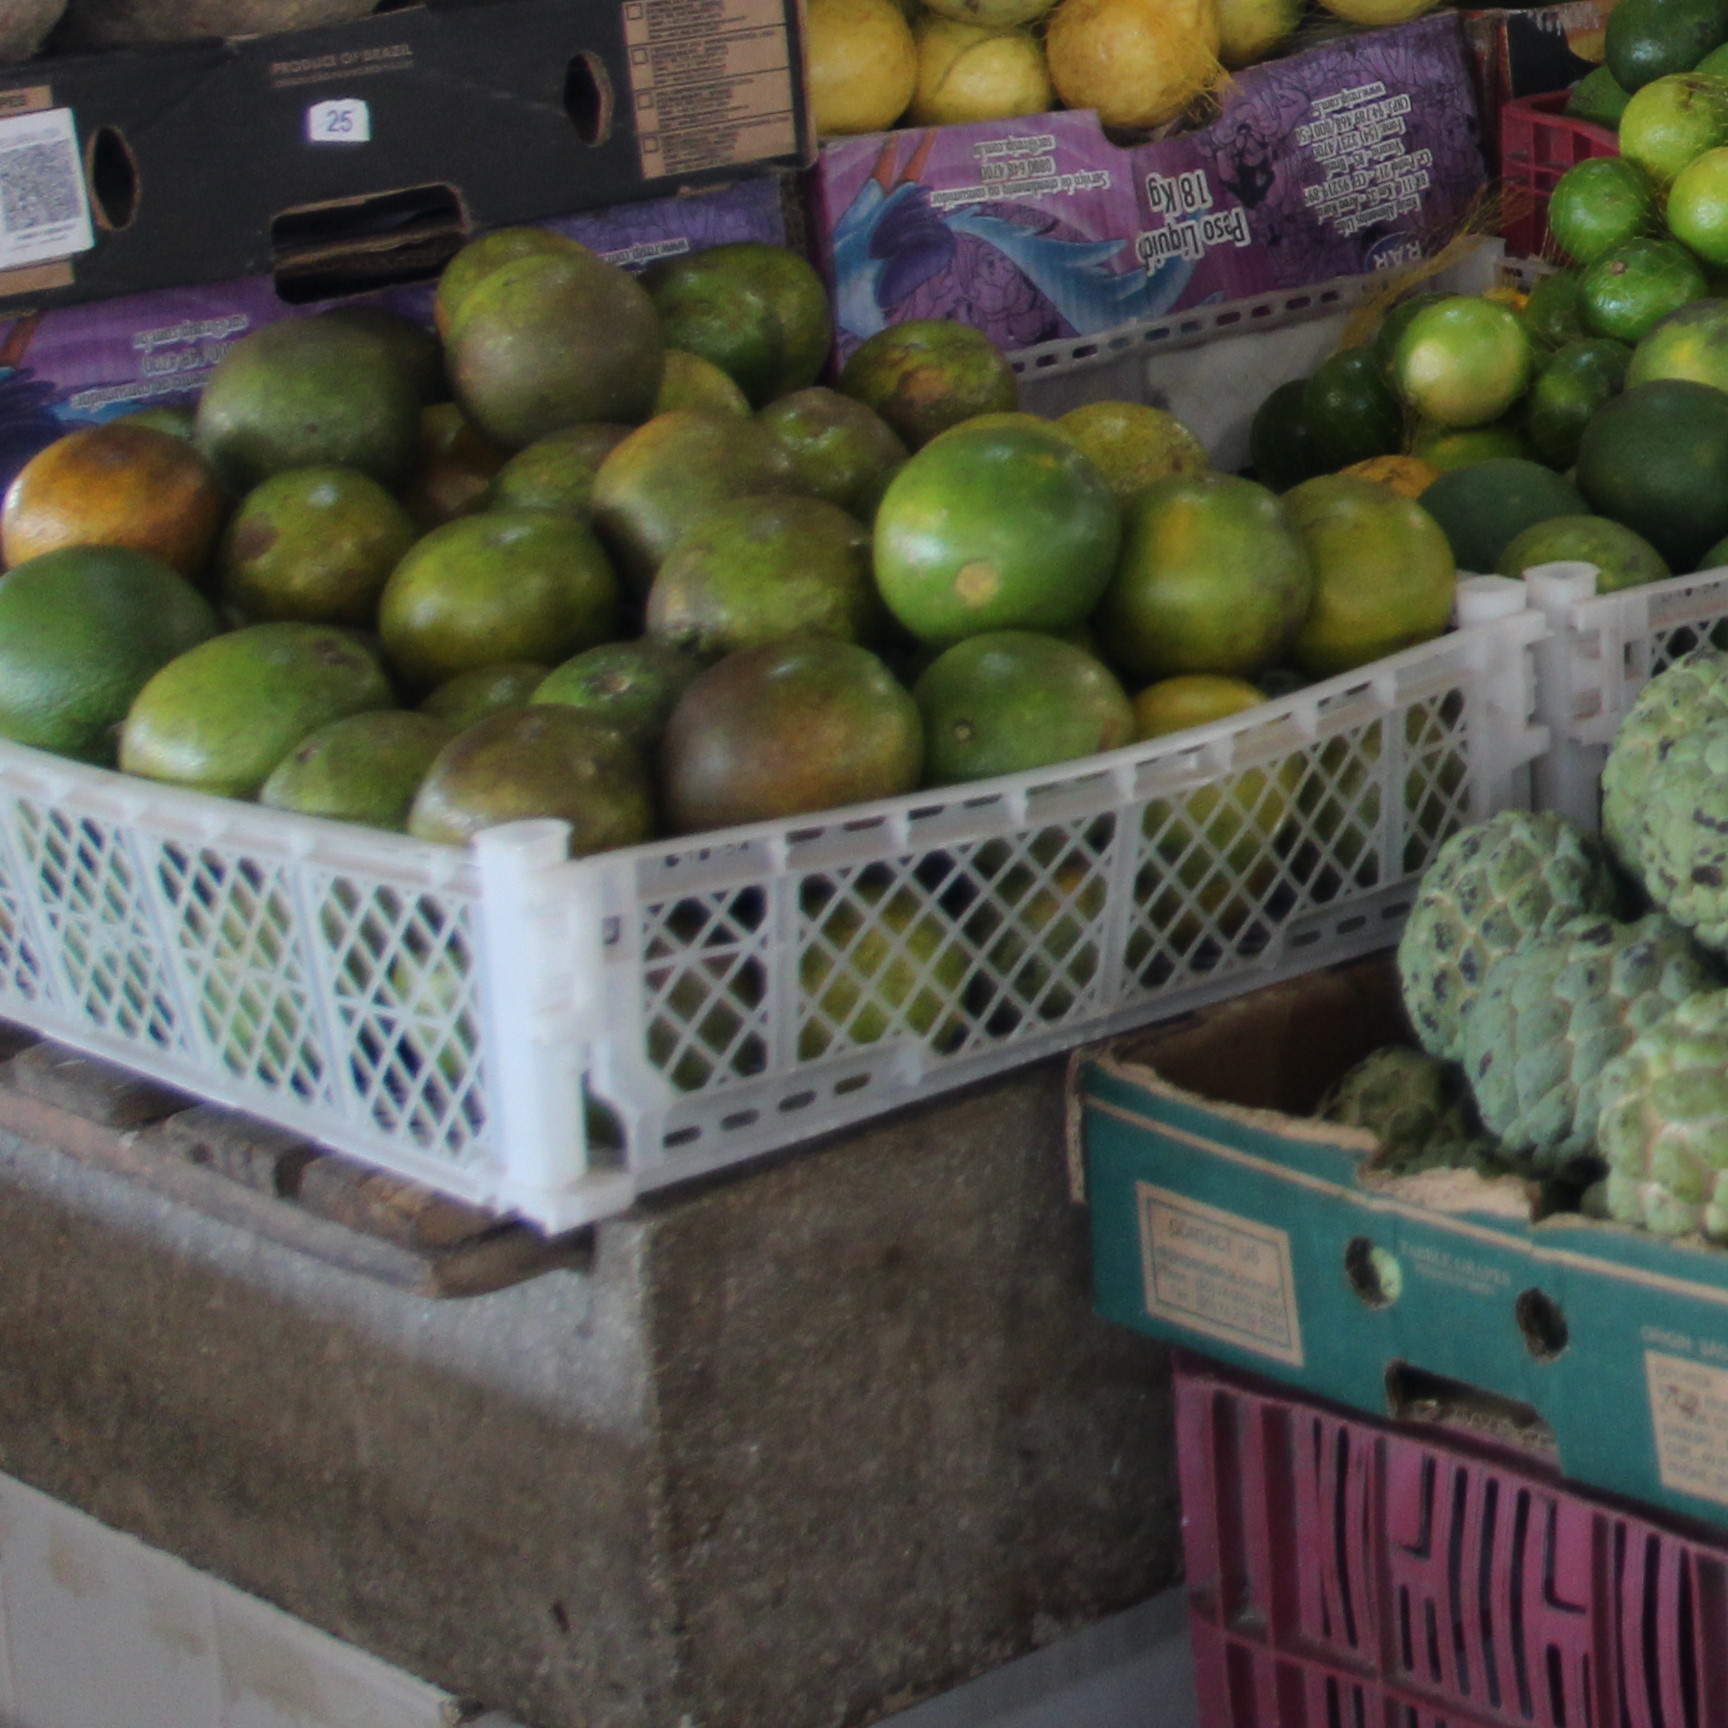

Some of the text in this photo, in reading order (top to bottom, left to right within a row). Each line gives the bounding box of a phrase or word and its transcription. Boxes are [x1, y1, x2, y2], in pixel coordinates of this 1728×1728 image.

[326, 109, 353, 133] 25
[1147, 174, 1207, 214] 18 Kg
[1203, 212, 1244, 242] Peso
